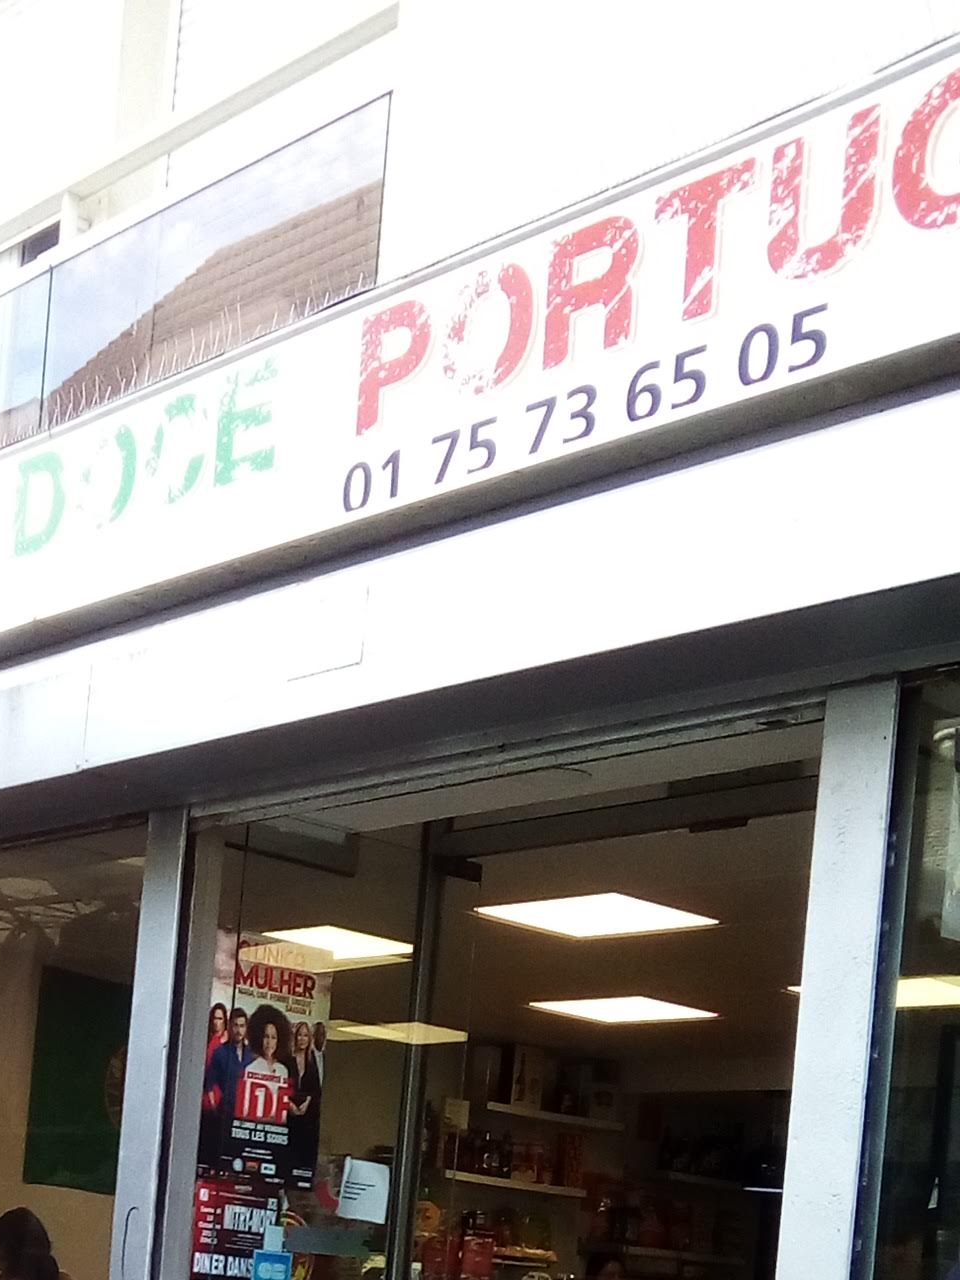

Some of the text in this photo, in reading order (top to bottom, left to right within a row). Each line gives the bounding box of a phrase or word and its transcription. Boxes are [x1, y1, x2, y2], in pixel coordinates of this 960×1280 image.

[342, 303, 829, 513] 01 75 73 65 05
[11, 355, 280, 557] DOCE
[235, 962, 316, 1000] MULHER
[251, 1130, 265, 1142] LES
[193, 1251, 254, 1278] DINER DANS
